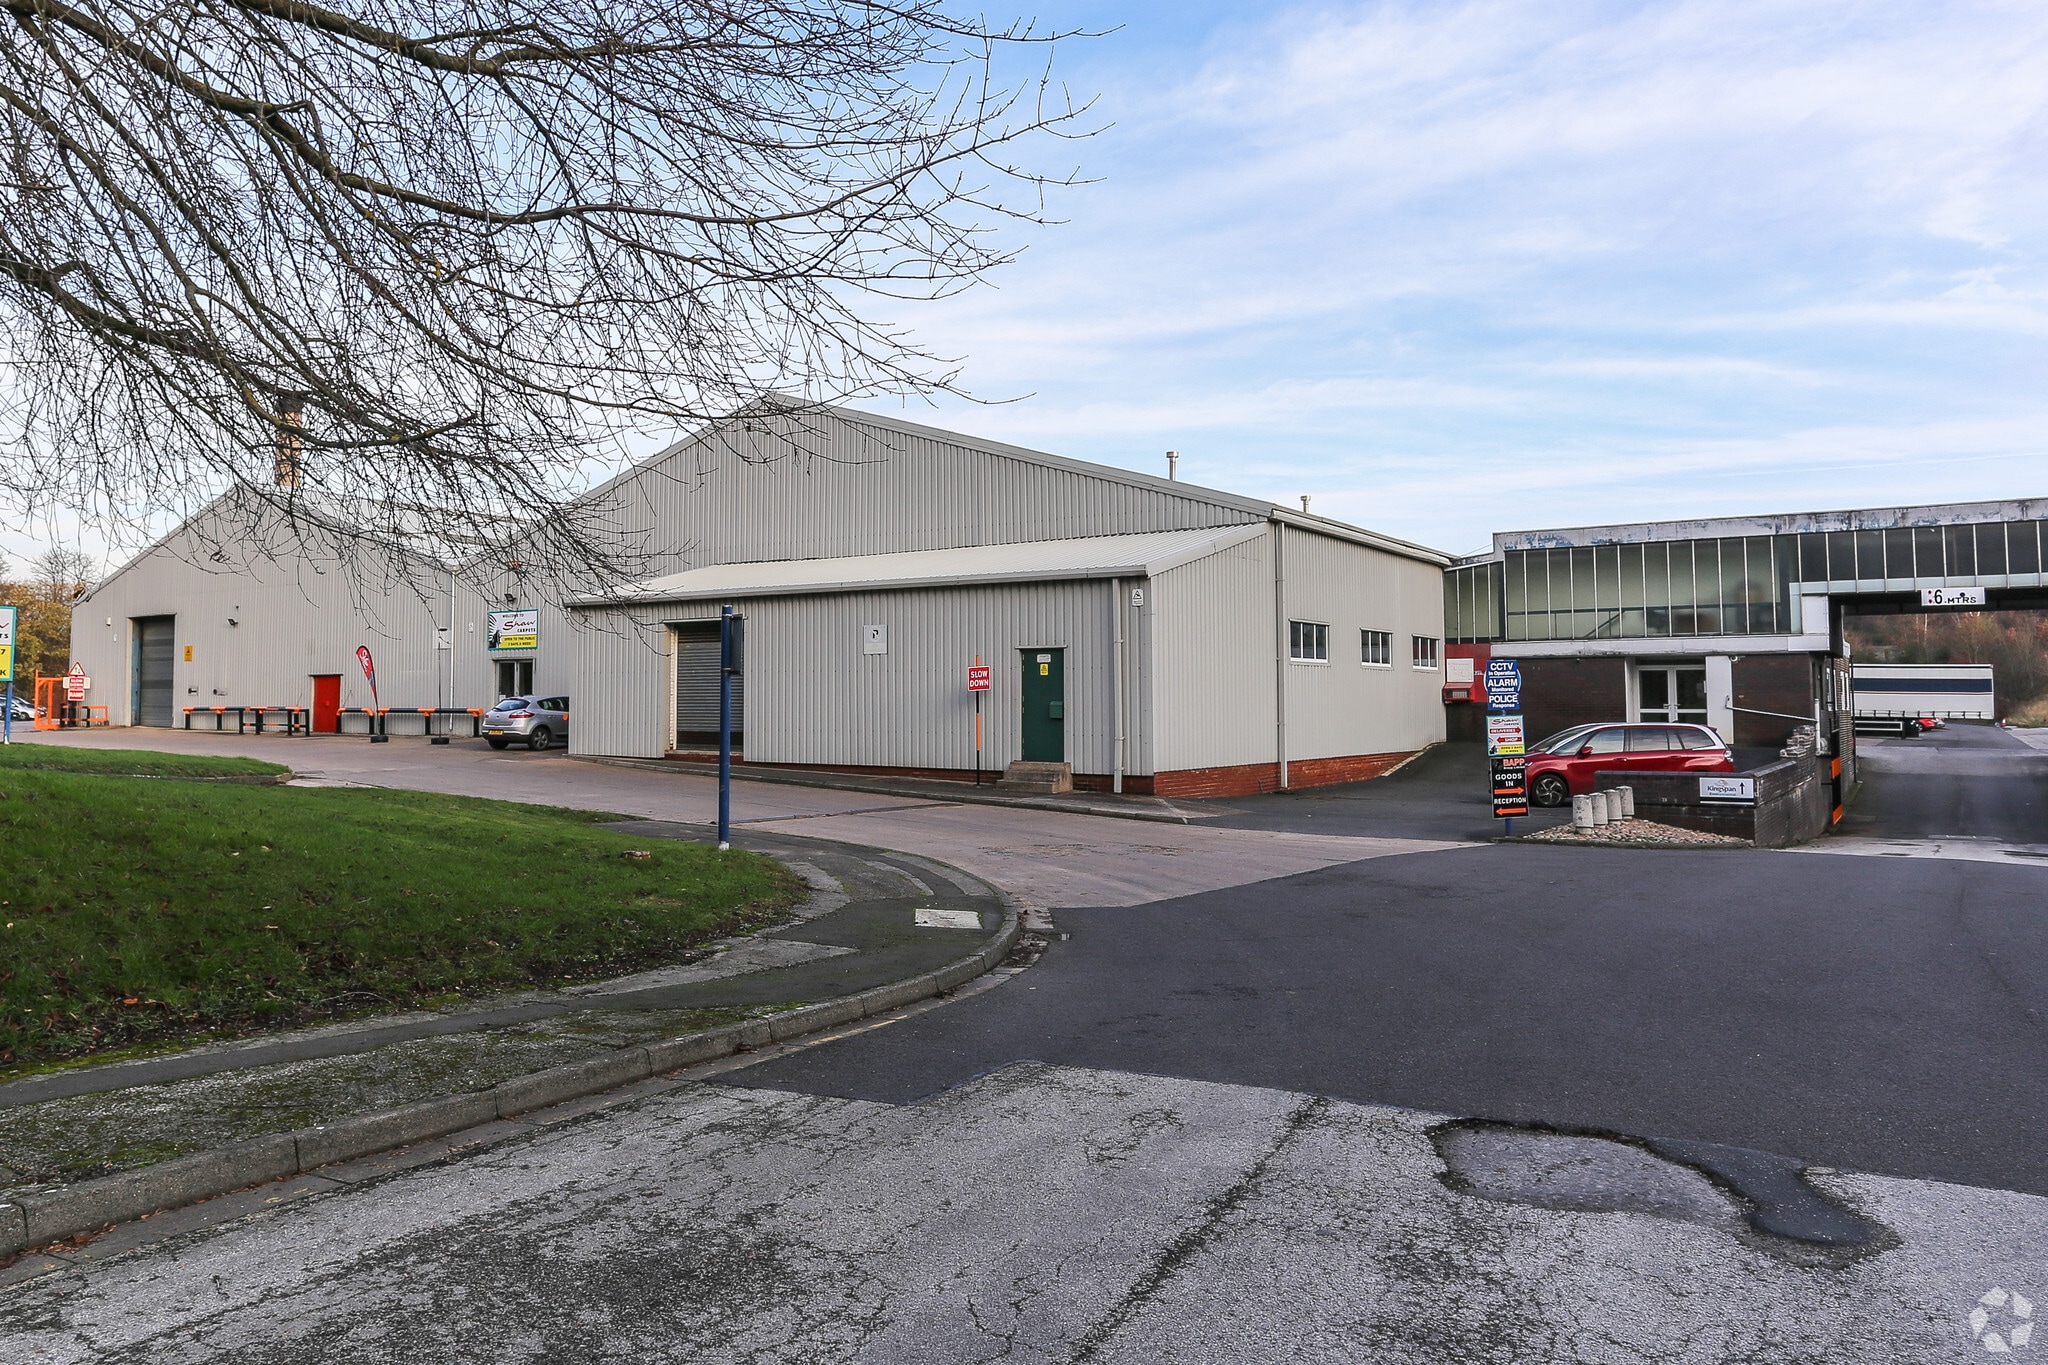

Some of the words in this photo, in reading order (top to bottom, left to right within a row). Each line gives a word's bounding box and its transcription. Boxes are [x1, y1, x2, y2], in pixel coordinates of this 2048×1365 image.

[503, 620, 536, 630] Shaw
[1490, 662, 1513, 670] CCTV
[1488, 679, 1517, 687] ALARM
[1489, 695, 1518, 703] POLICE
[1503, 758, 1525, 767] BAPP
